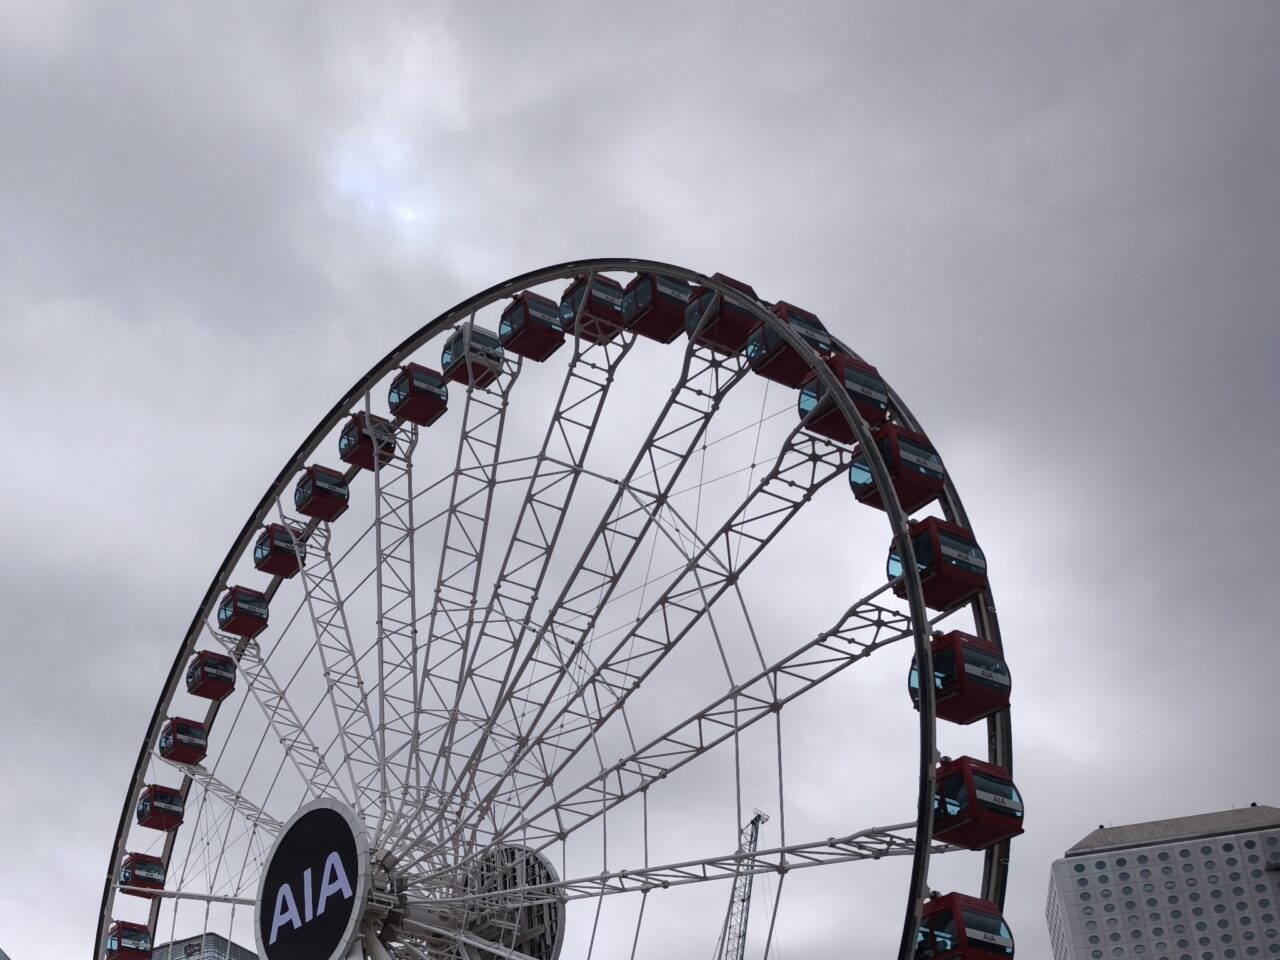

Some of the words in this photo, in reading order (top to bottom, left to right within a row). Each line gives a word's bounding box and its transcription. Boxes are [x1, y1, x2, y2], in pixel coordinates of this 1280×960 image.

[981, 670, 994, 680] AIA
[993, 796, 1006, 805] AIA
[269, 851, 353, 945] AIA
[983, 933, 996, 942] AIA
